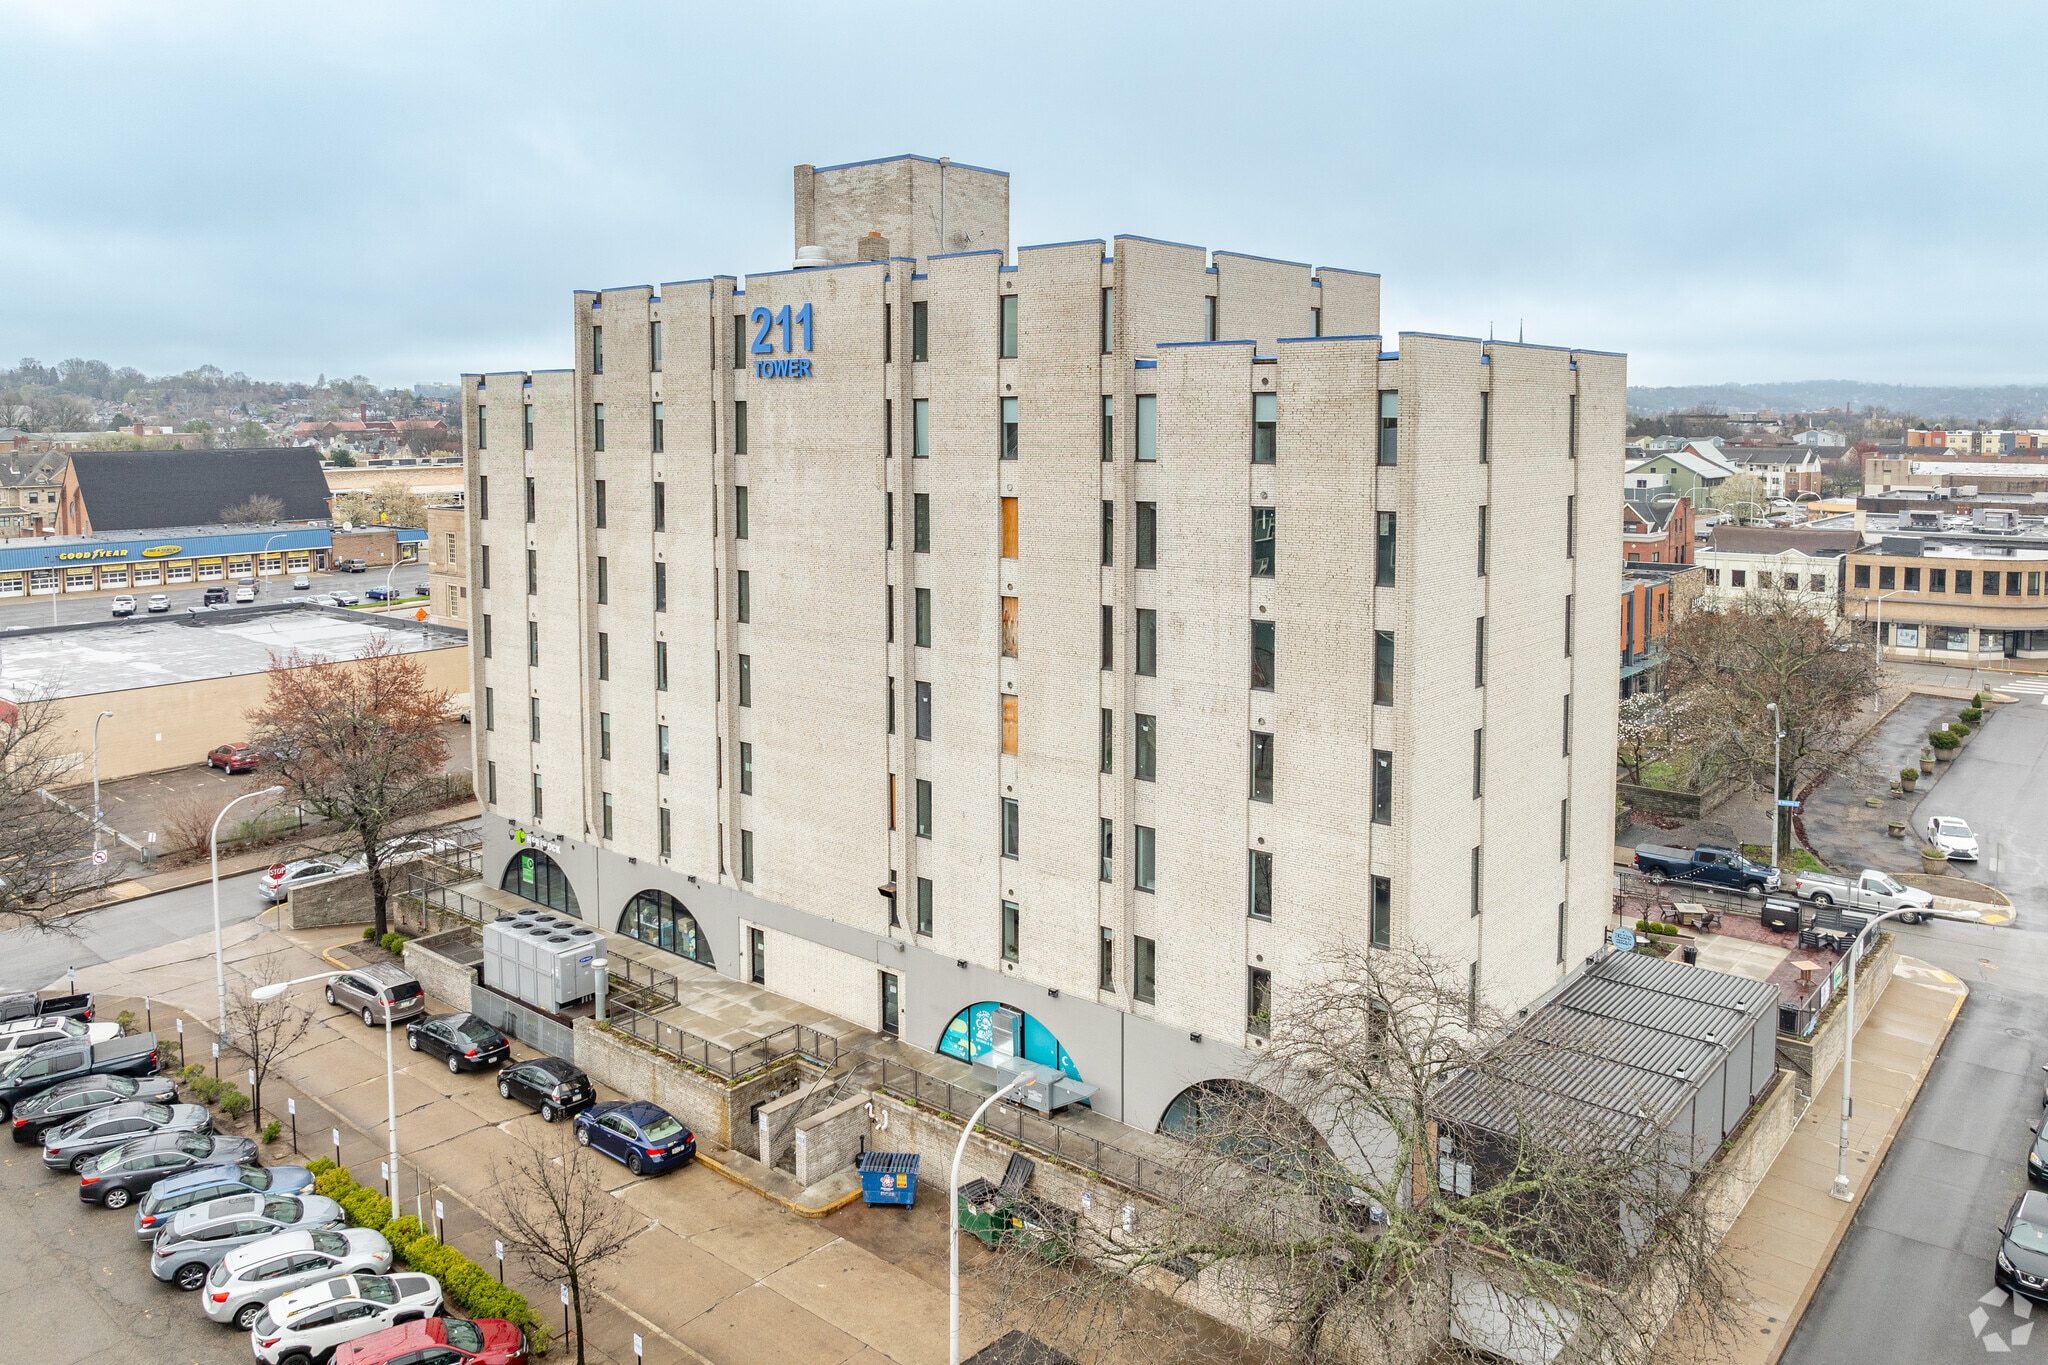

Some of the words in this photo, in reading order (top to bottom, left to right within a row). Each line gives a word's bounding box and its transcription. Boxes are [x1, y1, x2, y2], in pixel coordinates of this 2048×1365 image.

[751, 302, 813, 354] 211
[753, 358, 812, 378] TOWER
[59, 548, 128, 560] GOODYEAR
[270, 867, 286, 876] STOP
